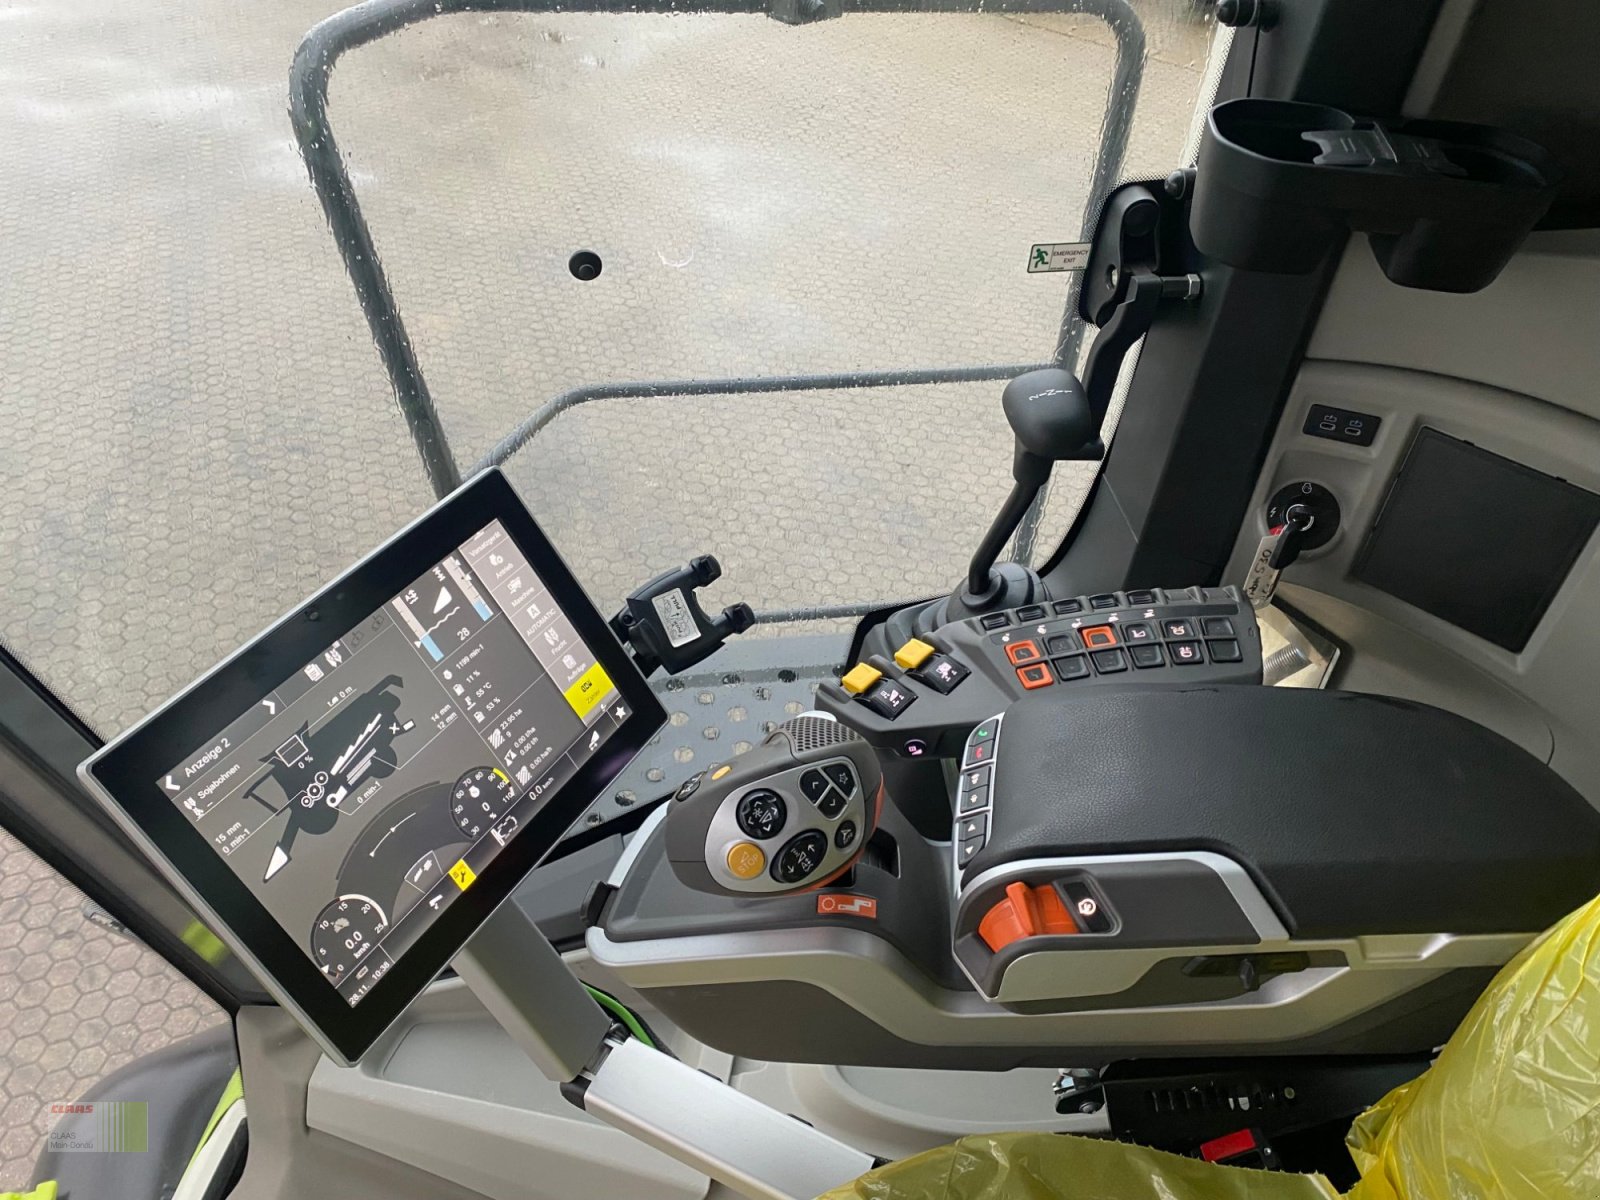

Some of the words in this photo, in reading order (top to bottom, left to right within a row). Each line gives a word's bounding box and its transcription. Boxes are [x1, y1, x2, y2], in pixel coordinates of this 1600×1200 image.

[496, 563, 514, 579] Antrieb
[511, 587, 535, 607] Maschine
[527, 608, 556, 636] AUTOMATIC
[457, 627, 470, 641] 28
[551, 640, 567, 655] Frucht
[456, 655, 470, 670] 1199
[469, 643, 484, 659] min-1
[466, 675, 475, 683] 11
[473, 669, 480, 677] %
[345, 686, 353, 694] m
[476, 688, 485, 697] 55
[431, 713, 440, 722] 14
[439, 704, 451, 715] mm
[486, 702, 495, 711] 53
[437, 721, 446, 730] 12
[445, 712, 457, 724] mm
[500, 714, 515, 730] 23.95
[514, 708, 523, 718] ha
[514, 736, 526, 748] 0.00
[520, 743, 531, 755] 0.00
[184, 745, 222, 778] Anzeige
[221, 737, 231, 748] 2
[297, 761, 305, 769] 0
[305, 755, 314, 763] %
[530, 757, 542, 770] 0.00
[197, 763, 240, 799] Sojabohnen
[463, 778, 472, 787] 70
[475, 771, 484, 781] 80
[487, 773, 496, 782] 90
[357, 796, 364, 804] 0
[363, 780, 381, 798] min-1
[497, 780, 507, 791] 100
[529, 785, 543, 801] 0.0
[542, 777, 554, 790] km/h
[456, 790, 464, 799] 60
[502, 791, 513, 803] 110
[454, 804, 464, 815] 50
[482, 802, 490, 812] 0
[460, 817, 469, 827] 40
[215, 833, 227, 844] 15
[226, 821, 242, 836] mm
[471, 825, 480, 835] 30
[222, 846, 230, 854] 0
[230, 828, 251, 848] min-1
[737, 854, 759, 873] STOP
[338, 902, 348, 912] 15
[361, 904, 371, 915] 20
[319, 920, 330, 930] 10
[374, 923, 384, 934] 25
[344, 931, 363, 950] 0.0
[319, 947, 327, 956] 5
[353, 942, 371, 959] km/h
[337, 964, 344, 972] 0
[348, 984, 370, 1005] 28.11.
[371, 961, 390, 980] 10:38
